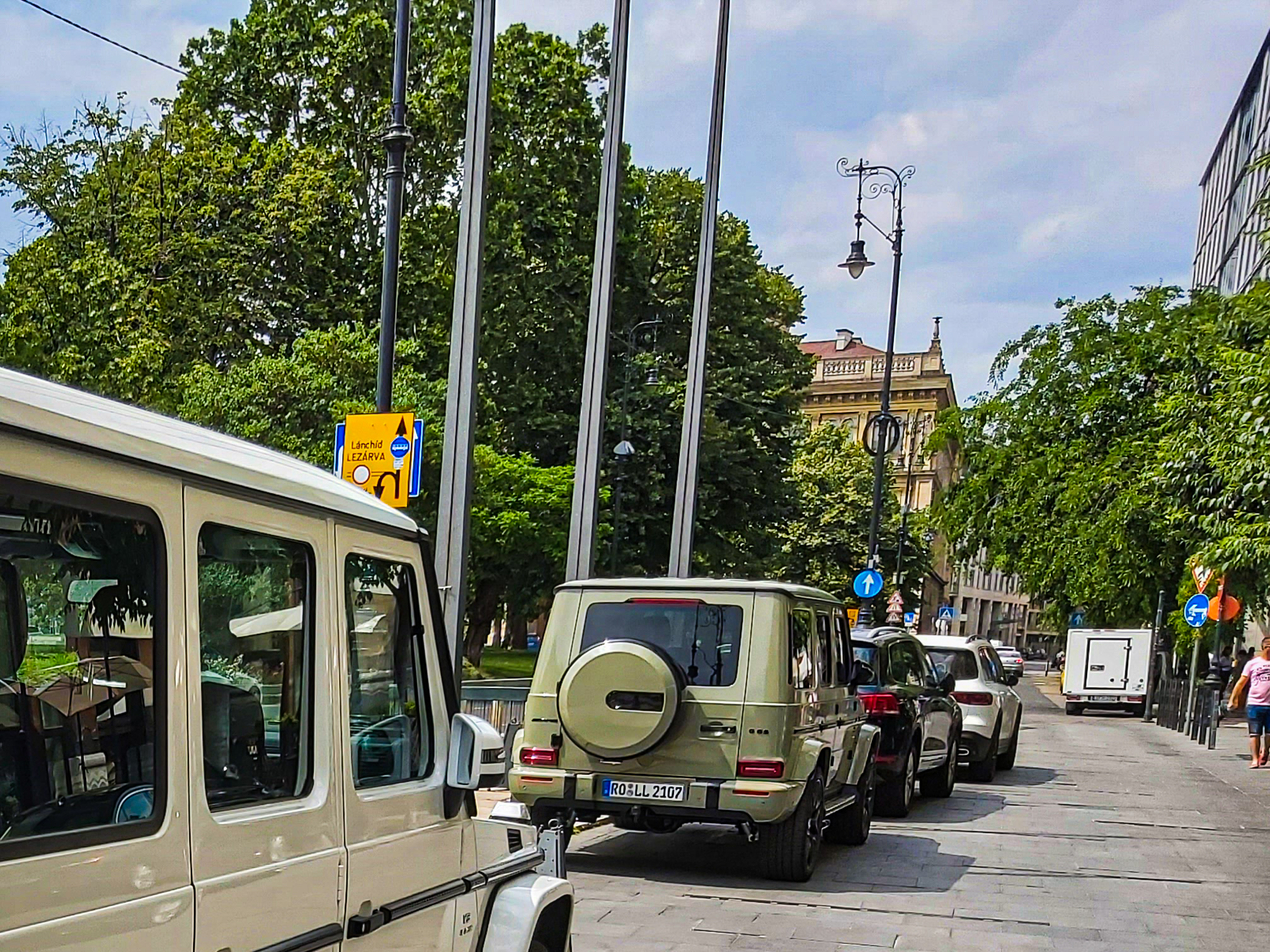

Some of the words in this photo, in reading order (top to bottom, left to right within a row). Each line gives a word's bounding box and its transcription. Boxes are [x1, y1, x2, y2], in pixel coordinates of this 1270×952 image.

[351, 439, 383, 450] Lánchíd
[346, 451, 386, 462] LEZÁRVA
[610, 782, 626, 796] RO
[634, 784, 650, 797] LL
[652, 785, 683, 800] 2107
